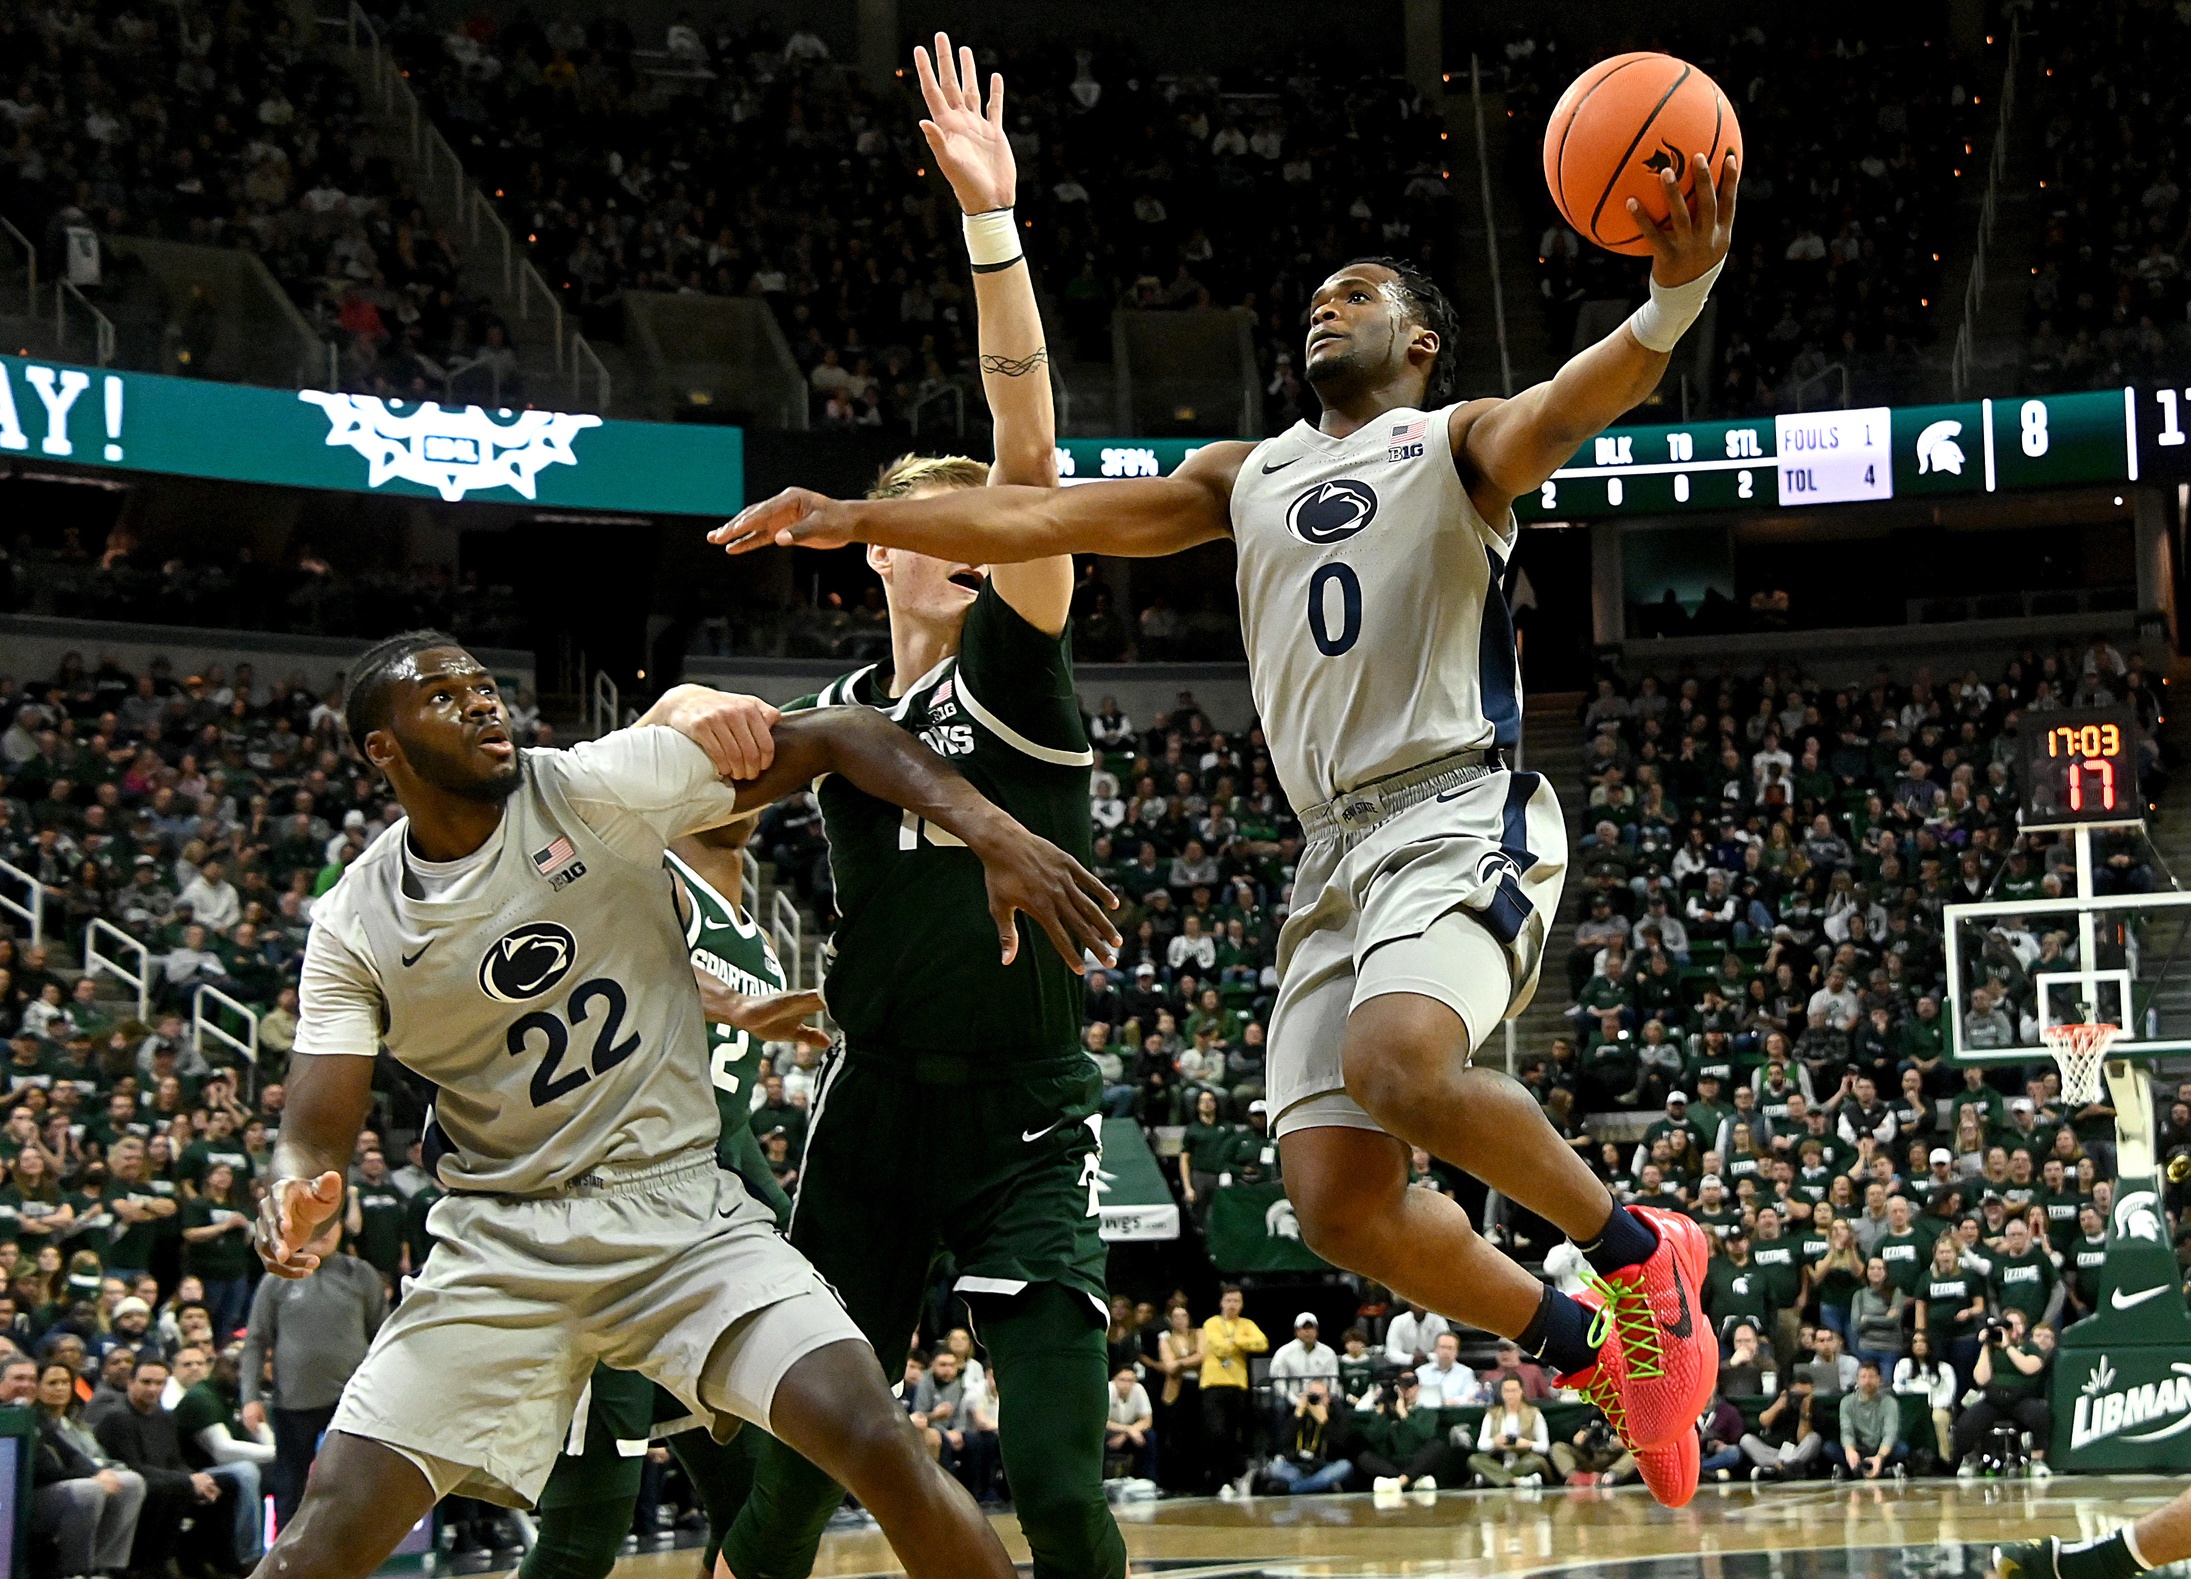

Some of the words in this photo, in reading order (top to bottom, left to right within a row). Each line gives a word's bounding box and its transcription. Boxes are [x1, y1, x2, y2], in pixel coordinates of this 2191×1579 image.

[1785, 427, 1839, 452] FOULS
[1864, 424, 1873, 447] 1
[2020, 399, 2049, 458] 8
[2156, 386, 2191, 447] 1
[1594, 436, 1633, 465] BLK
[1666, 432, 1694, 462] TO
[1725, 429, 1763, 458] STL
[1541, 480, 1557, 509] 2
[1607, 477, 1624, 507] 0
[1674, 473, 1690, 503] 0
[1737, 470, 1754, 498] 2
[1784, 468, 1818, 493] TOL
[1863, 462, 1876, 488] 4
[1307, 561, 1362, 657] 0
[2048, 723, 2120, 758] 17:03
[1355, 801, 1379, 814] STATE
[2069, 759, 2115, 811] 17
[506, 977, 642, 1109] 22
[2070, 1376, 2191, 1450] LIBMAN
